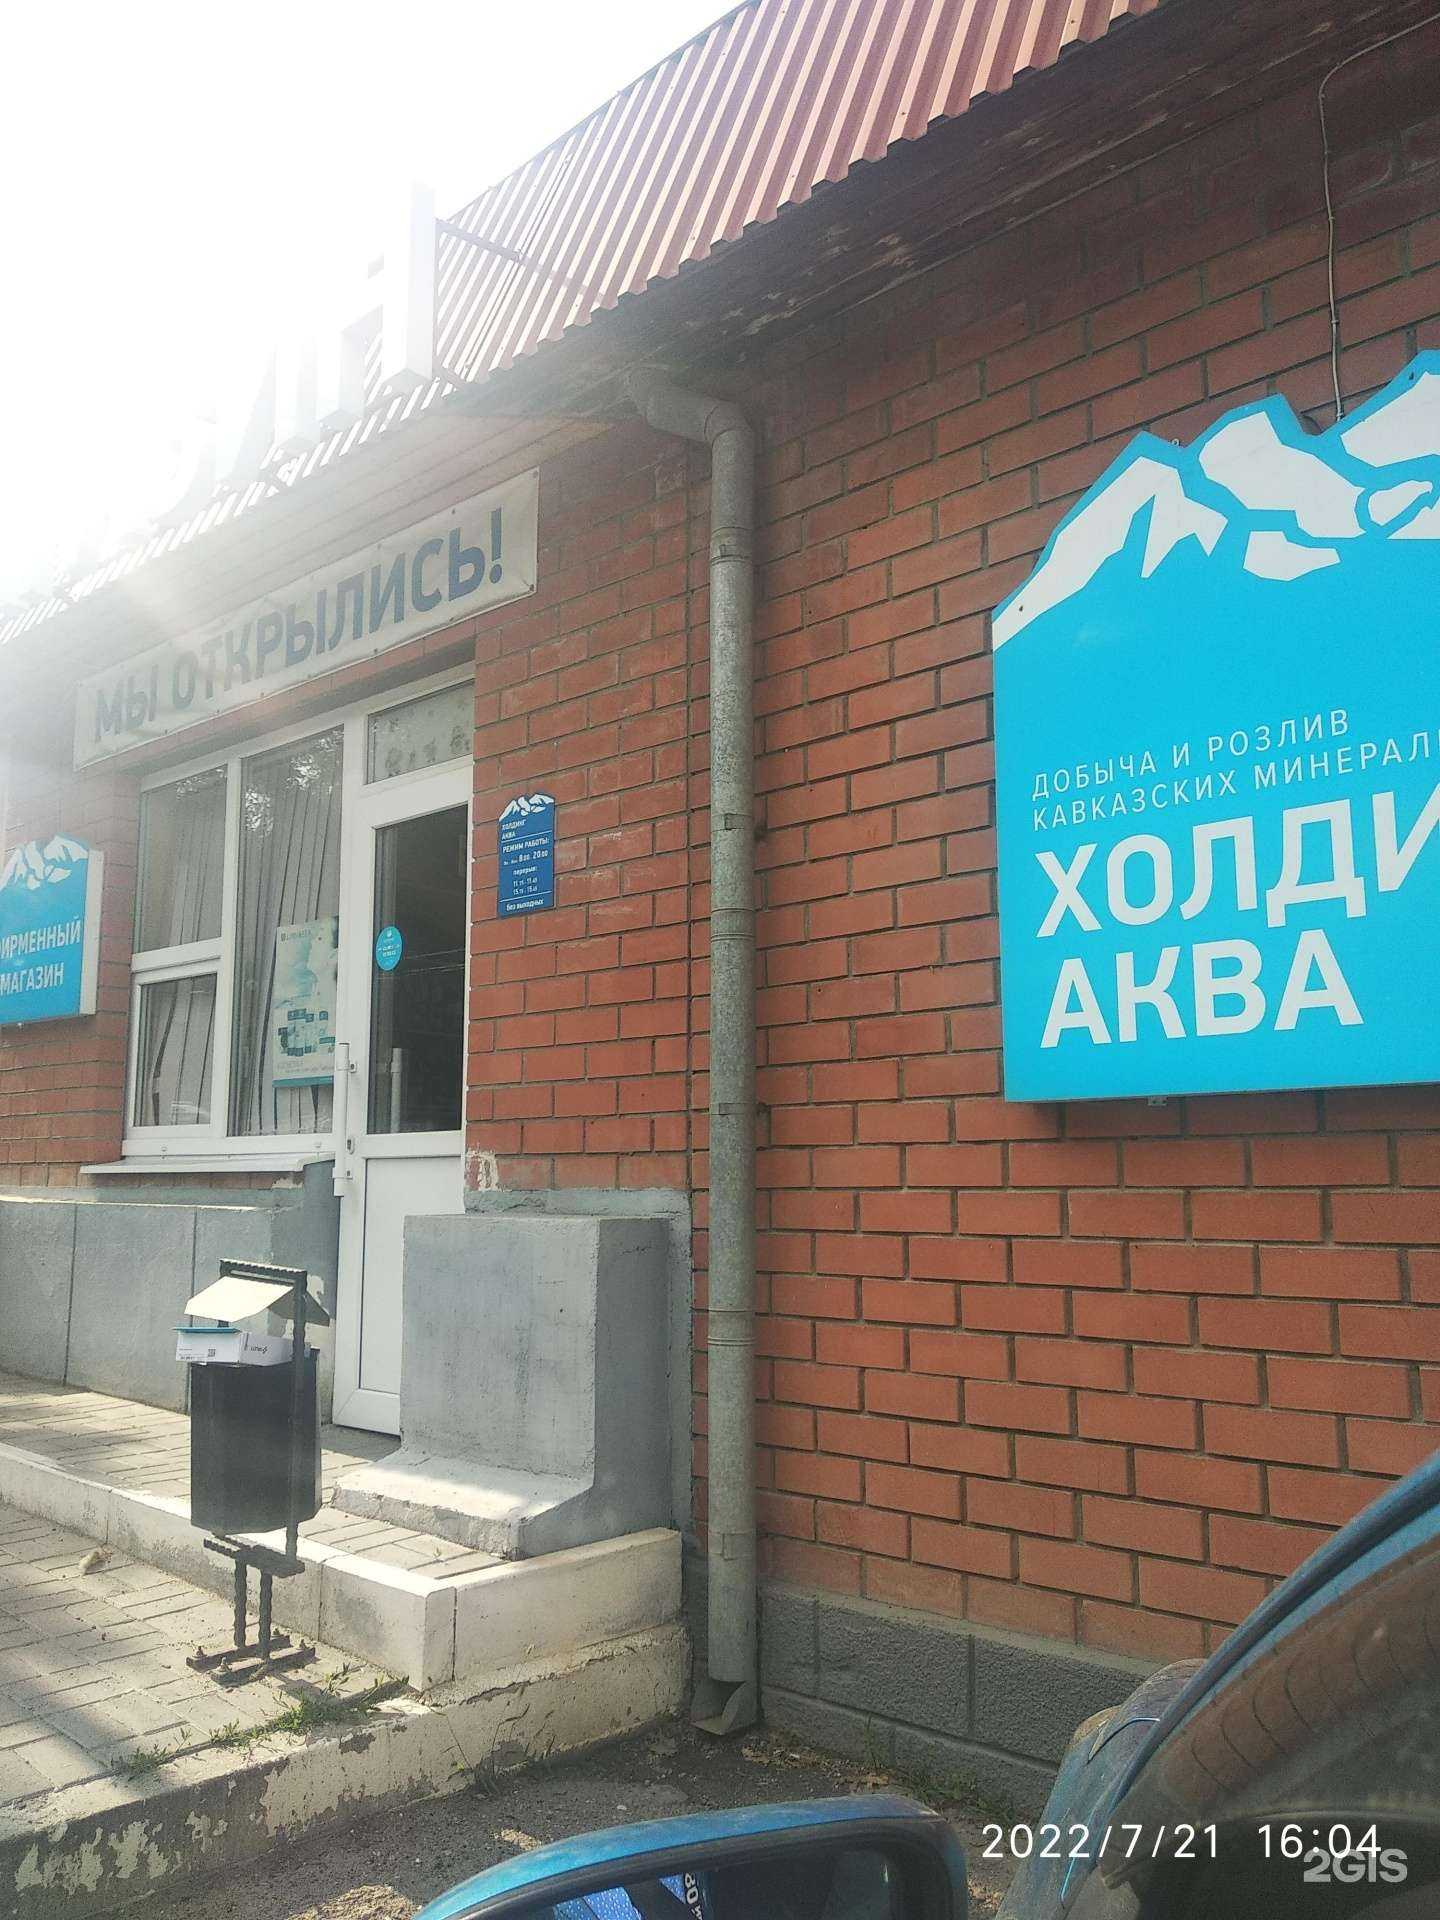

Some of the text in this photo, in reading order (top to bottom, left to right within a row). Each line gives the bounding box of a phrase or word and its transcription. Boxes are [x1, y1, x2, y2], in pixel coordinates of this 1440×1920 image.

[95, 508, 504, 743] МЫ ОТКРЫЛИСЬ!
[1031, 708, 1349, 802] ДОБЫЧА И РОЗЛИВ
[1032, 729, 1440, 832] КАВКАЗСКИХ МИНЕРАЛ
[502, 841, 524, 854] РЕЖИМ
[1035, 783, 1440, 939] ХОЛДИ
[0, 915, 82, 960] ИРМЕННЫЙ
[0, 961, 65, 997] МАГАЗИН
[1040, 929, 1364, 1049] АКВА
